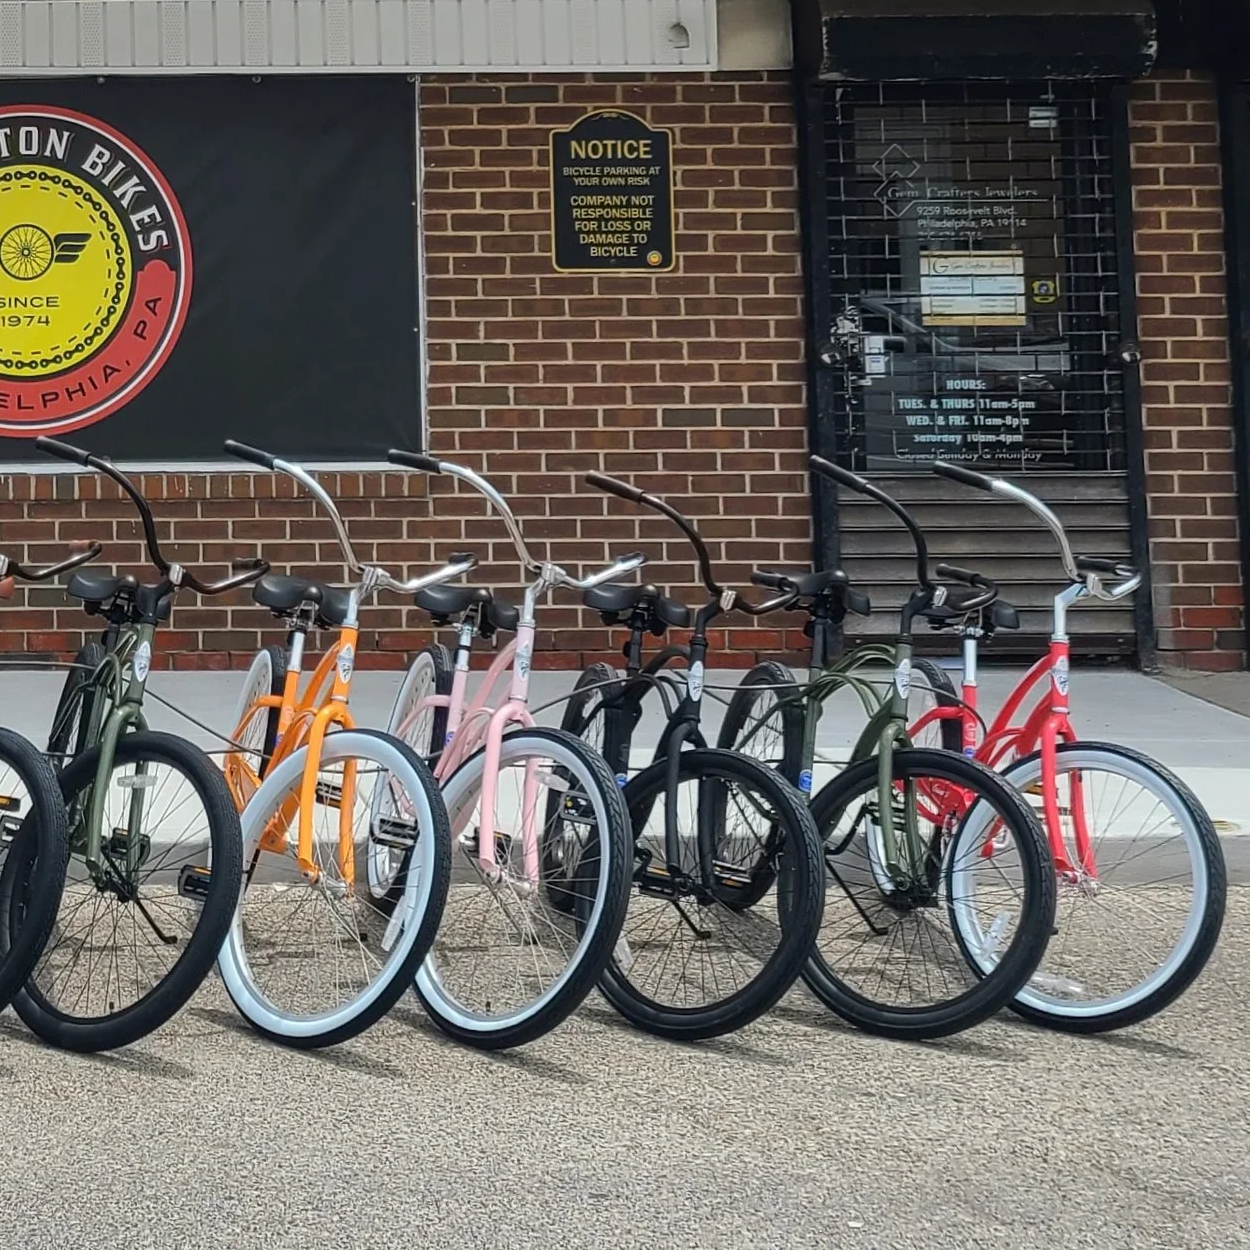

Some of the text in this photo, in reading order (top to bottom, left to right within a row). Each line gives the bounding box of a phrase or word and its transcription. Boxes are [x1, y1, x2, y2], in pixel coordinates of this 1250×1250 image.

[570, 140, 653, 160] NOTICE
[563, 166, 661, 176] BICYCLE PARKING AT
[573, 177, 651, 186] YOUR OWN RISK
[81, 143, 170, 252] BIKES
[570, 195, 655, 207] COMPANY NOT
[572, 208, 654, 219] RESPONSIBLE
[917, 206, 941, 216] 9259
[574, 221, 652, 231] FOR LOSS OR
[981, 219, 995, 228] PA
[579, 233, 648, 244] DAMAGE TO
[590, 246, 638, 257] BICYCLE
[0, 315, 51, 328] 1974
[134, 296, 163, 341] PA
[946, 379, 987, 390] HOURS:
[898, 398, 1036, 411] TUES. & THURS 11am-5pm
[906, 415, 1030, 428] WED. & FRI. 11am-8pm
[913, 433, 963, 445] Saturday
